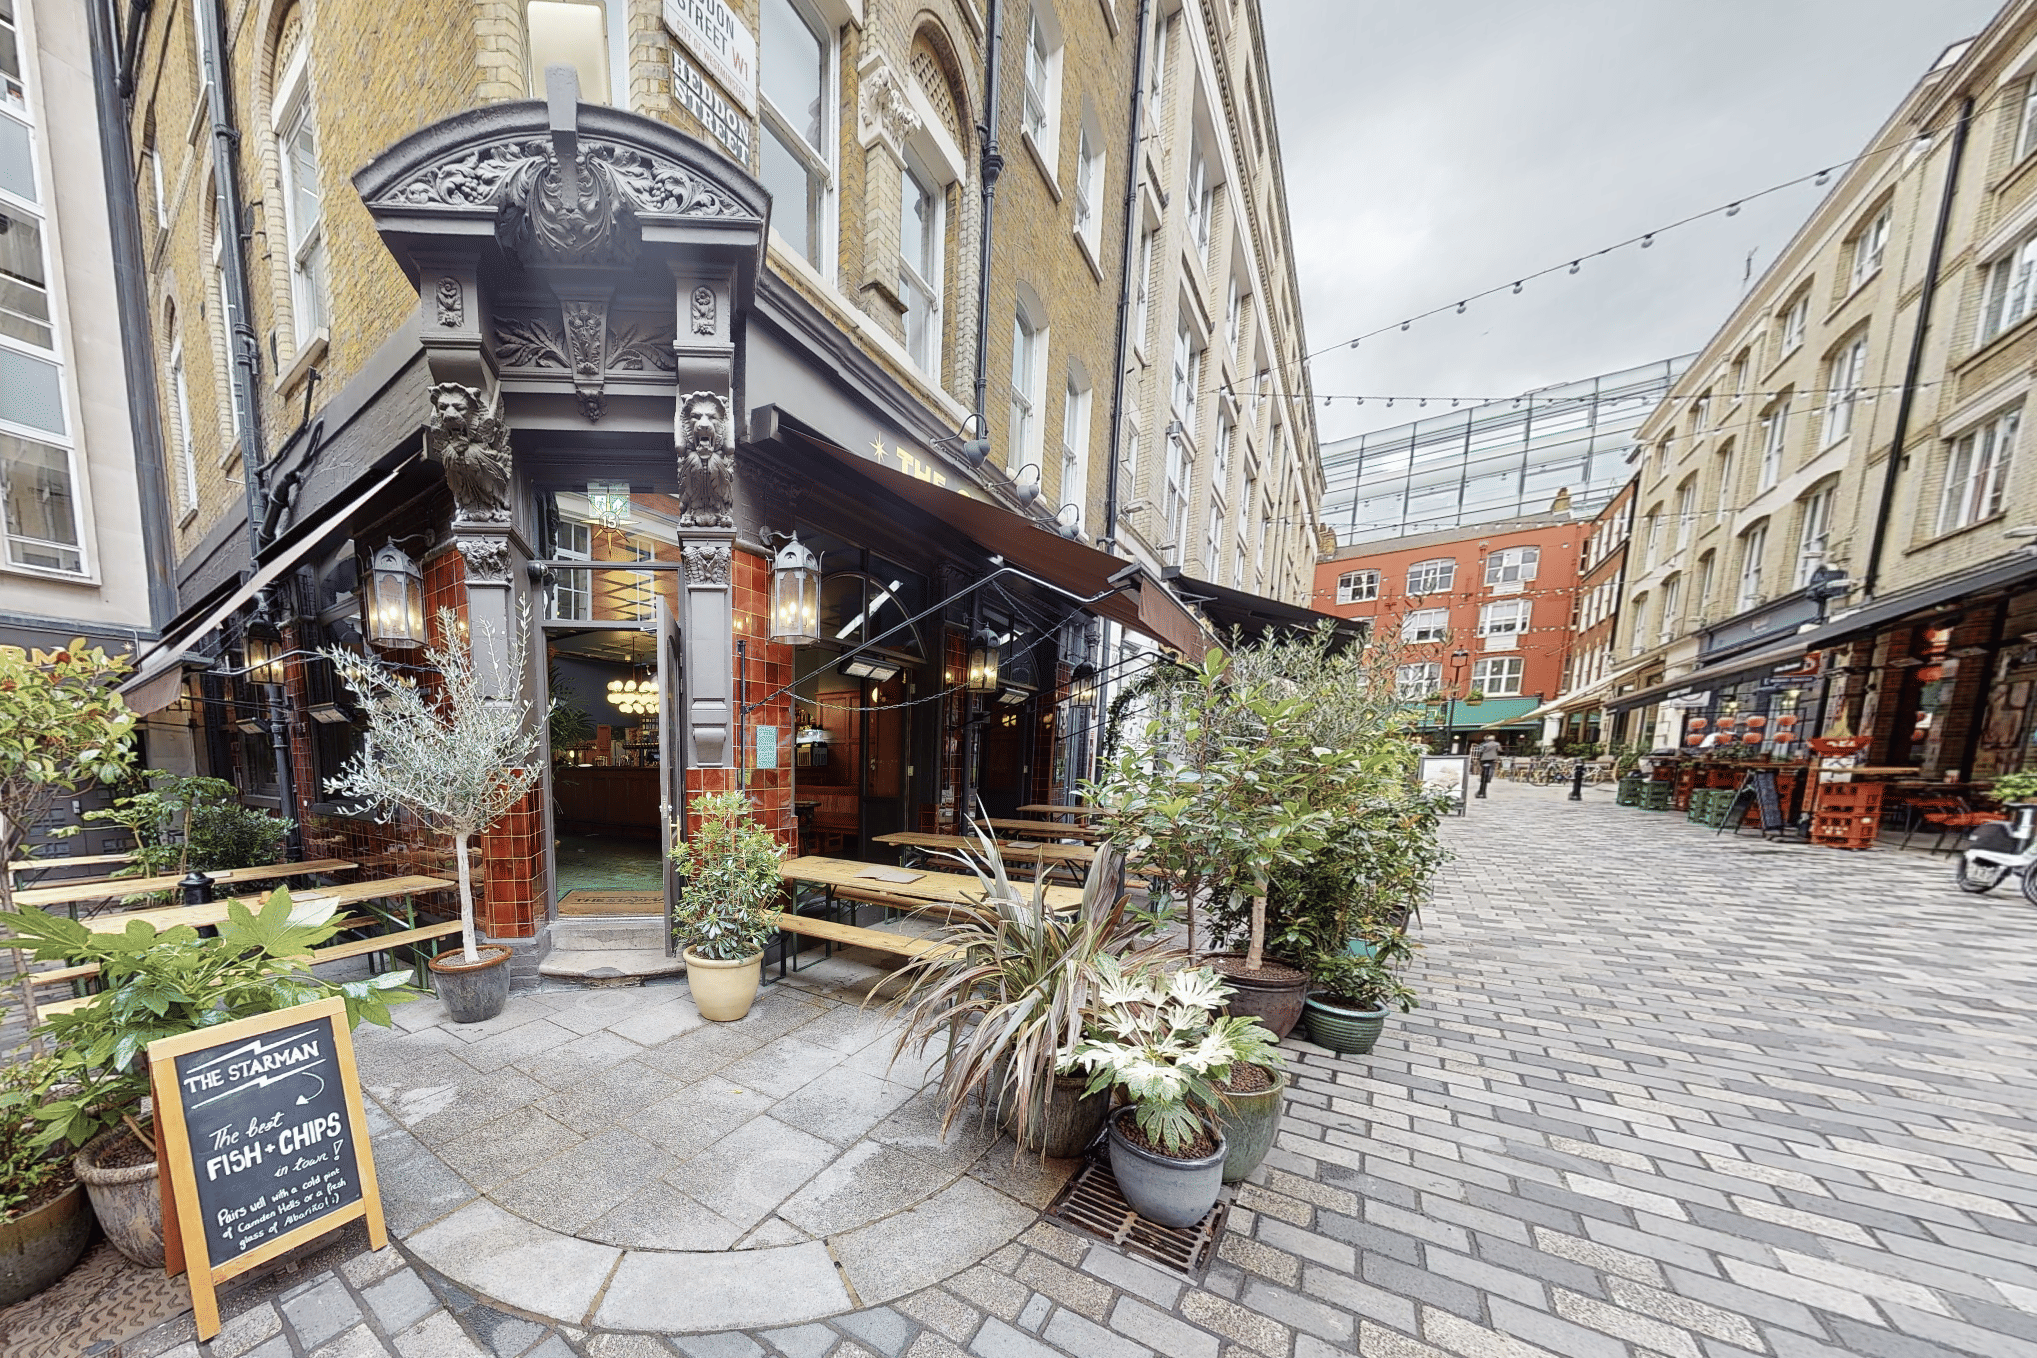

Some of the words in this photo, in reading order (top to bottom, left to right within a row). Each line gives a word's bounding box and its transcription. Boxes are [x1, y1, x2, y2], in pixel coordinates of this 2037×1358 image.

[700, 0, 734, 40] DON
[676, 20, 692, 42] CITY
[693, 38, 702, 52] OF
[703, 47, 746, 101] WESTMINSTER
[732, 46, 748, 82] W1
[673, 50, 749, 146] HEDDON
[674, 77, 749, 166] STREET
[602, 515, 618, 529] 15
[183, 1069, 225, 1093] THE
[228, 1040, 320, 1081] STARMAN
[206, 1141, 262, 1181] FISH
[279, 1112, 342, 1155] CHIPS
[208, 1123, 240, 1151] The
[245, 1111, 285, 1138] best
[274, 1165, 289, 1177] in
[292, 1152, 329, 1171] town
[217, 1206, 247, 1226] Pairs
[249, 1196, 267, 1212] well
[271, 1188, 290, 1202] with
[290, 1186, 298, 1194] a
[302, 1175, 321, 1190] cold
[323, 1167, 340, 1182] pint
[222, 1226, 234, 1239] of
[237, 1211, 276, 1232] Camden
[277, 1199, 301, 1214] Hells
[303, 1193, 314, 1203] or
[326, 1178, 347, 1195] fresh
[239, 1229, 265, 1250] glass
[268, 1221, 279, 1234] of
